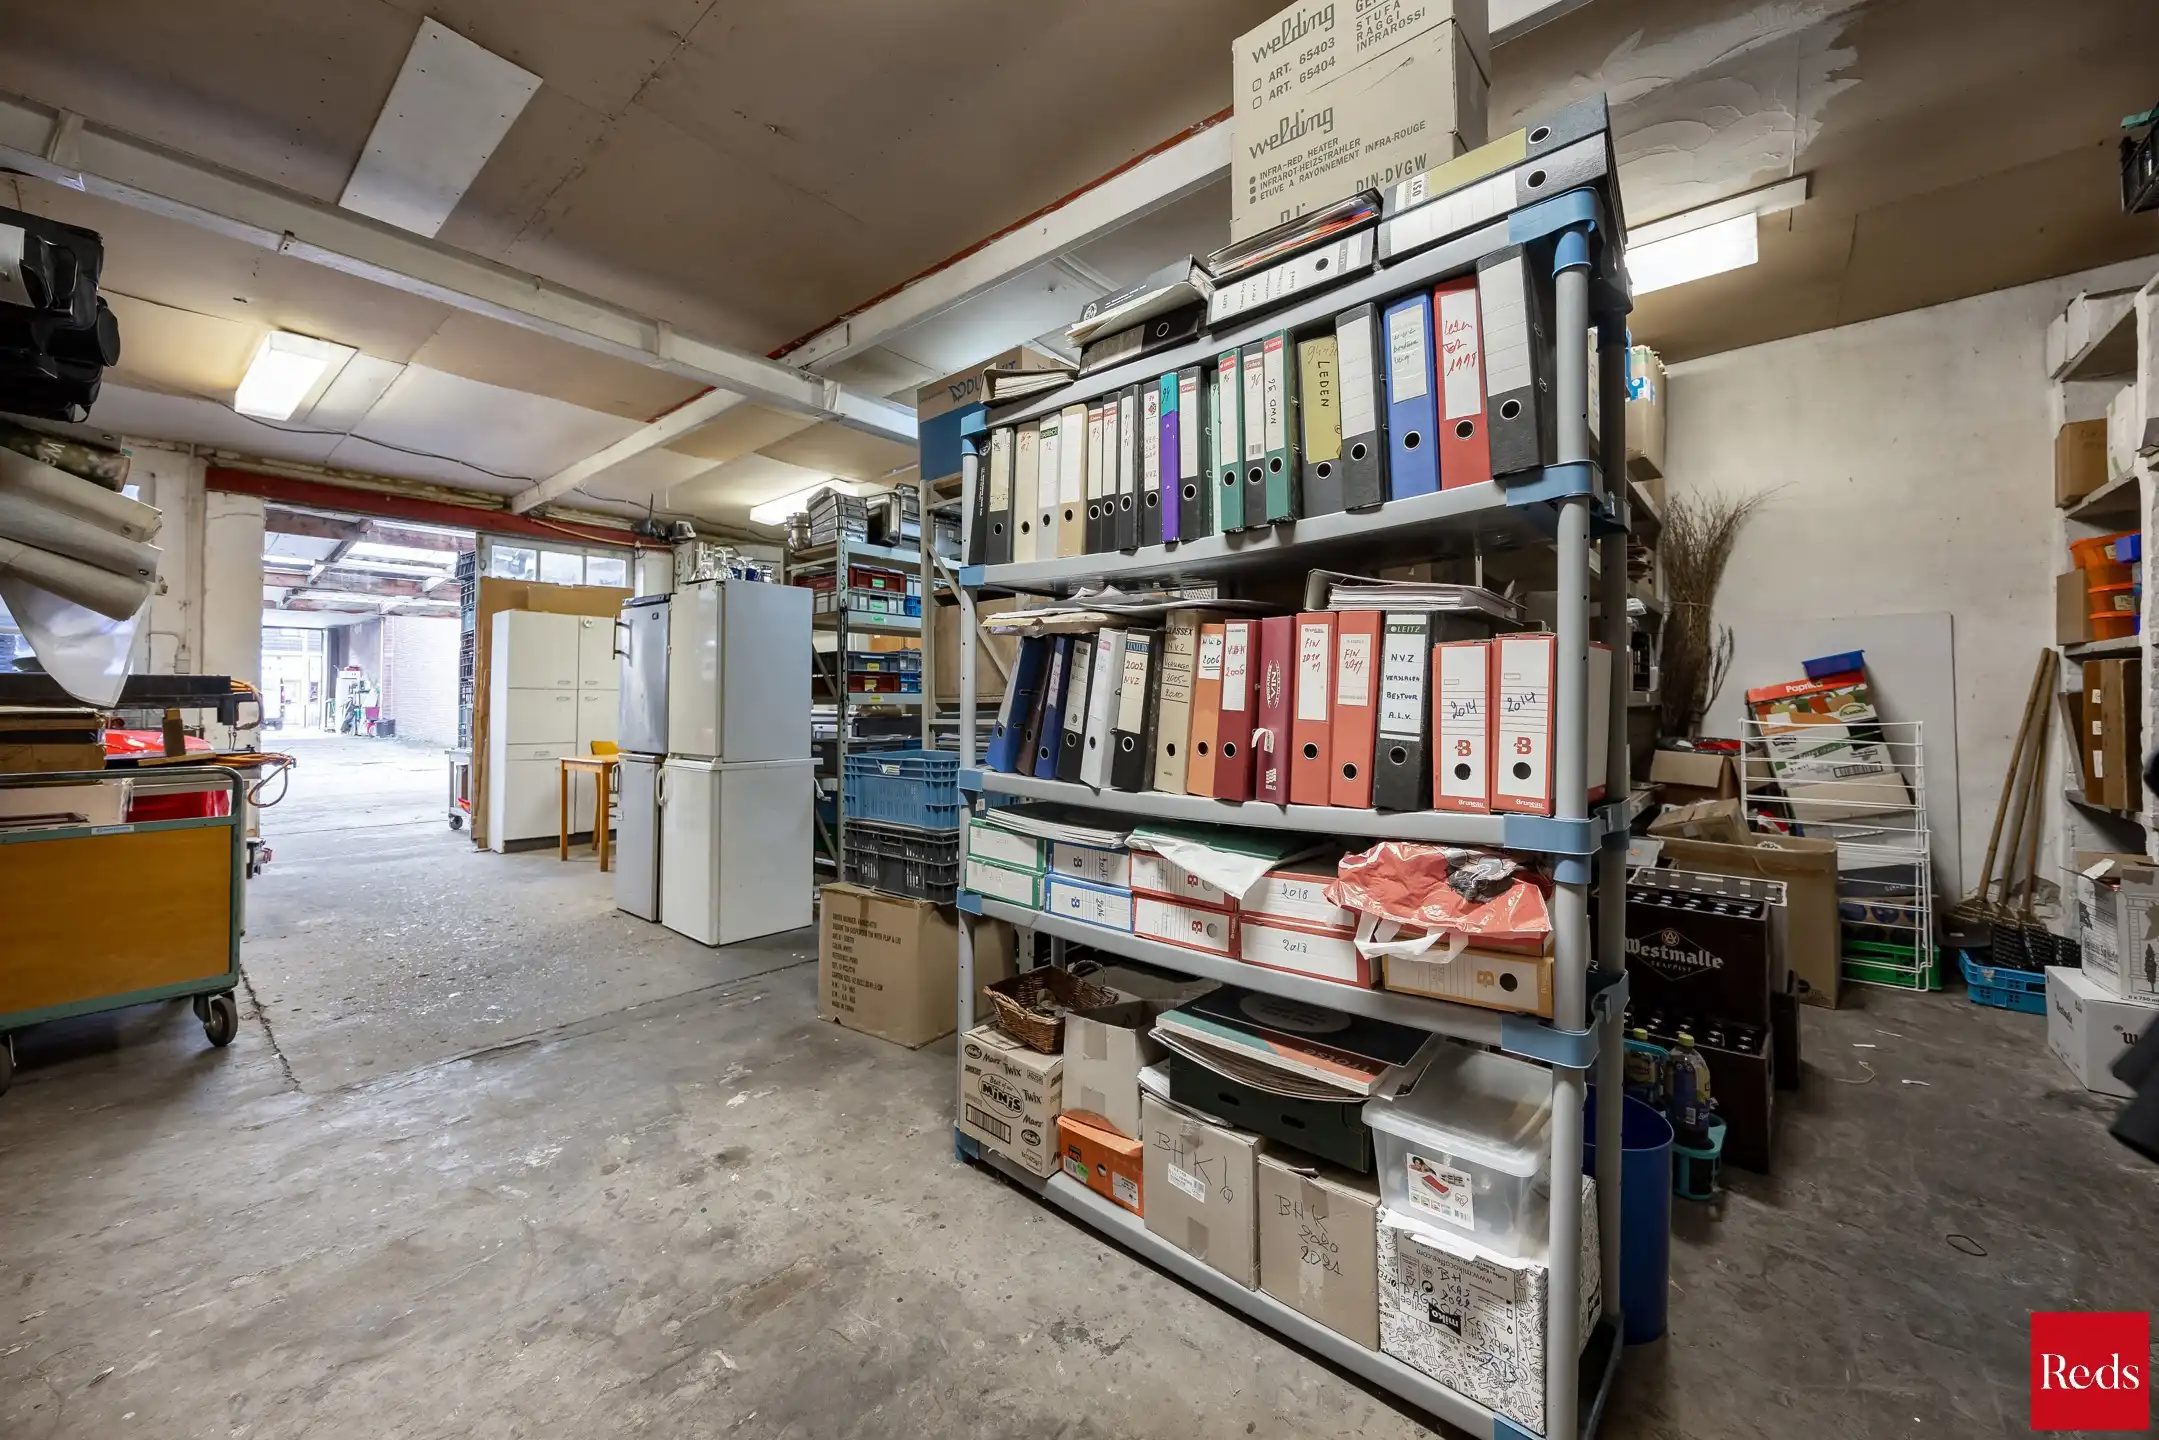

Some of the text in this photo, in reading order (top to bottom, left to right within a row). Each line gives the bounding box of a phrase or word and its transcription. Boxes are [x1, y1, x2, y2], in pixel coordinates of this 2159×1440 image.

[1252, 3, 1335, 63] welding
[1356, 10, 1400, 42] RAGGI
[1357, 6, 1426, 53] INFRAROSSI
[1268, 37, 1335, 83] ART. 65403
[1268, 56, 1335, 101] ART. 65404
[1249, 107, 1333, 159] welding
[1260, 137, 1339, 180] INFRA-RED HEATER
[1260, 120, 1426, 201] ETUVE A RAYONNEMENT INFRA-ROUGE
[1260, 138, 1361, 190] INFRAROT-HEIZSTRAHLER
[1356, 153, 1427, 193] DIN-DVGW
[1318, 361, 1330, 407] LEDEN
[1305, 638, 1320, 648] FIN
[1202, 655, 1220, 664] 2006
[1344, 648, 1360, 660] FIN
[1125, 661, 1144, 671] 2002
[1225, 664, 1244, 677] 2006
[1451, 699, 1477, 720] 2014
[1508, 692, 1536, 712] 2014
[1458, 799, 1485, 808] Bruneau
[1516, 799, 1545, 809] Bruneau
[1282, 883, 1308, 899] 2018
[1625, 938, 1725, 969] Westmalle
[1003, 1062, 1022, 1077] Twix
[1022, 1088, 1042, 1104] Twix
[1415, 1249, 1494, 1285] www.mikocoffee.com
[1400, 1295, 1429, 1313] coffee
[1431, 1309, 1460, 1328] miko
